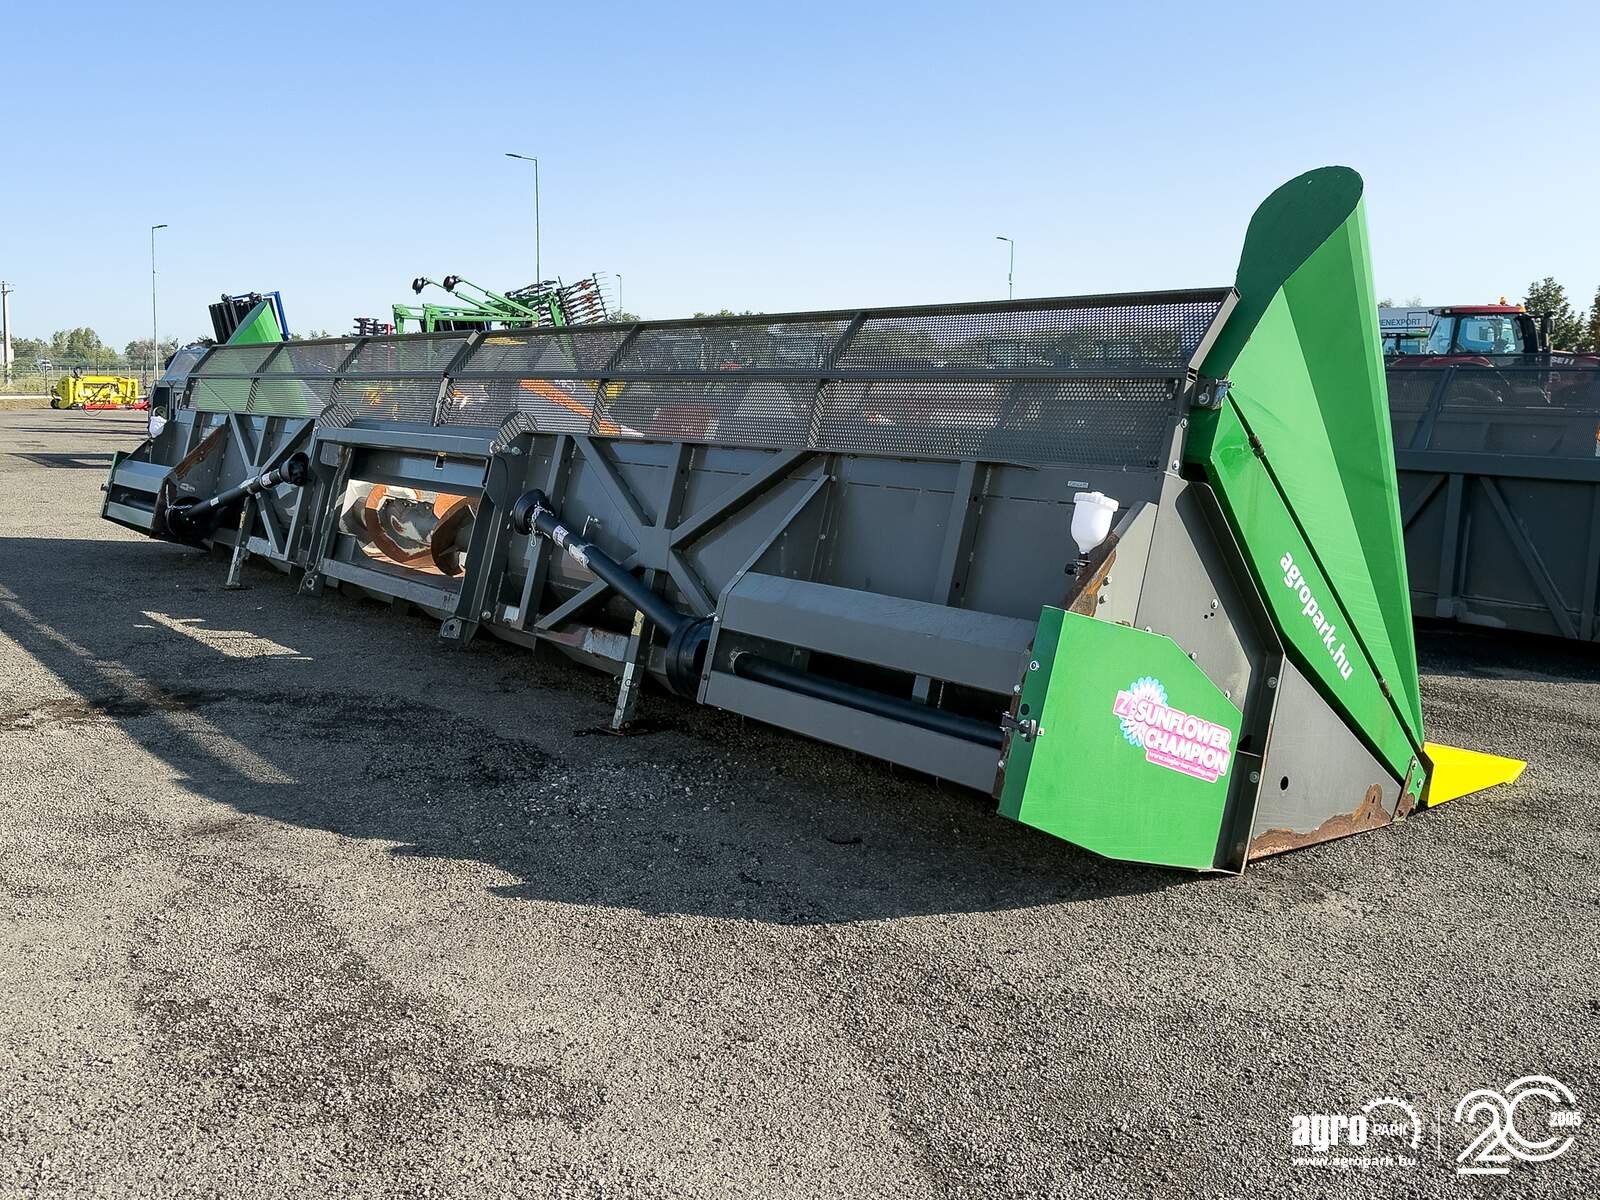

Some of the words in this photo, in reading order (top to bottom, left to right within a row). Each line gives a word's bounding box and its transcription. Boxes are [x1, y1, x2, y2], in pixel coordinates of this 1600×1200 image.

[1280, 552, 1354, 681] agropark.hu
[1135, 701, 1229, 748] SUNFLOWER
[1144, 728, 1229, 773] CHAMPION
